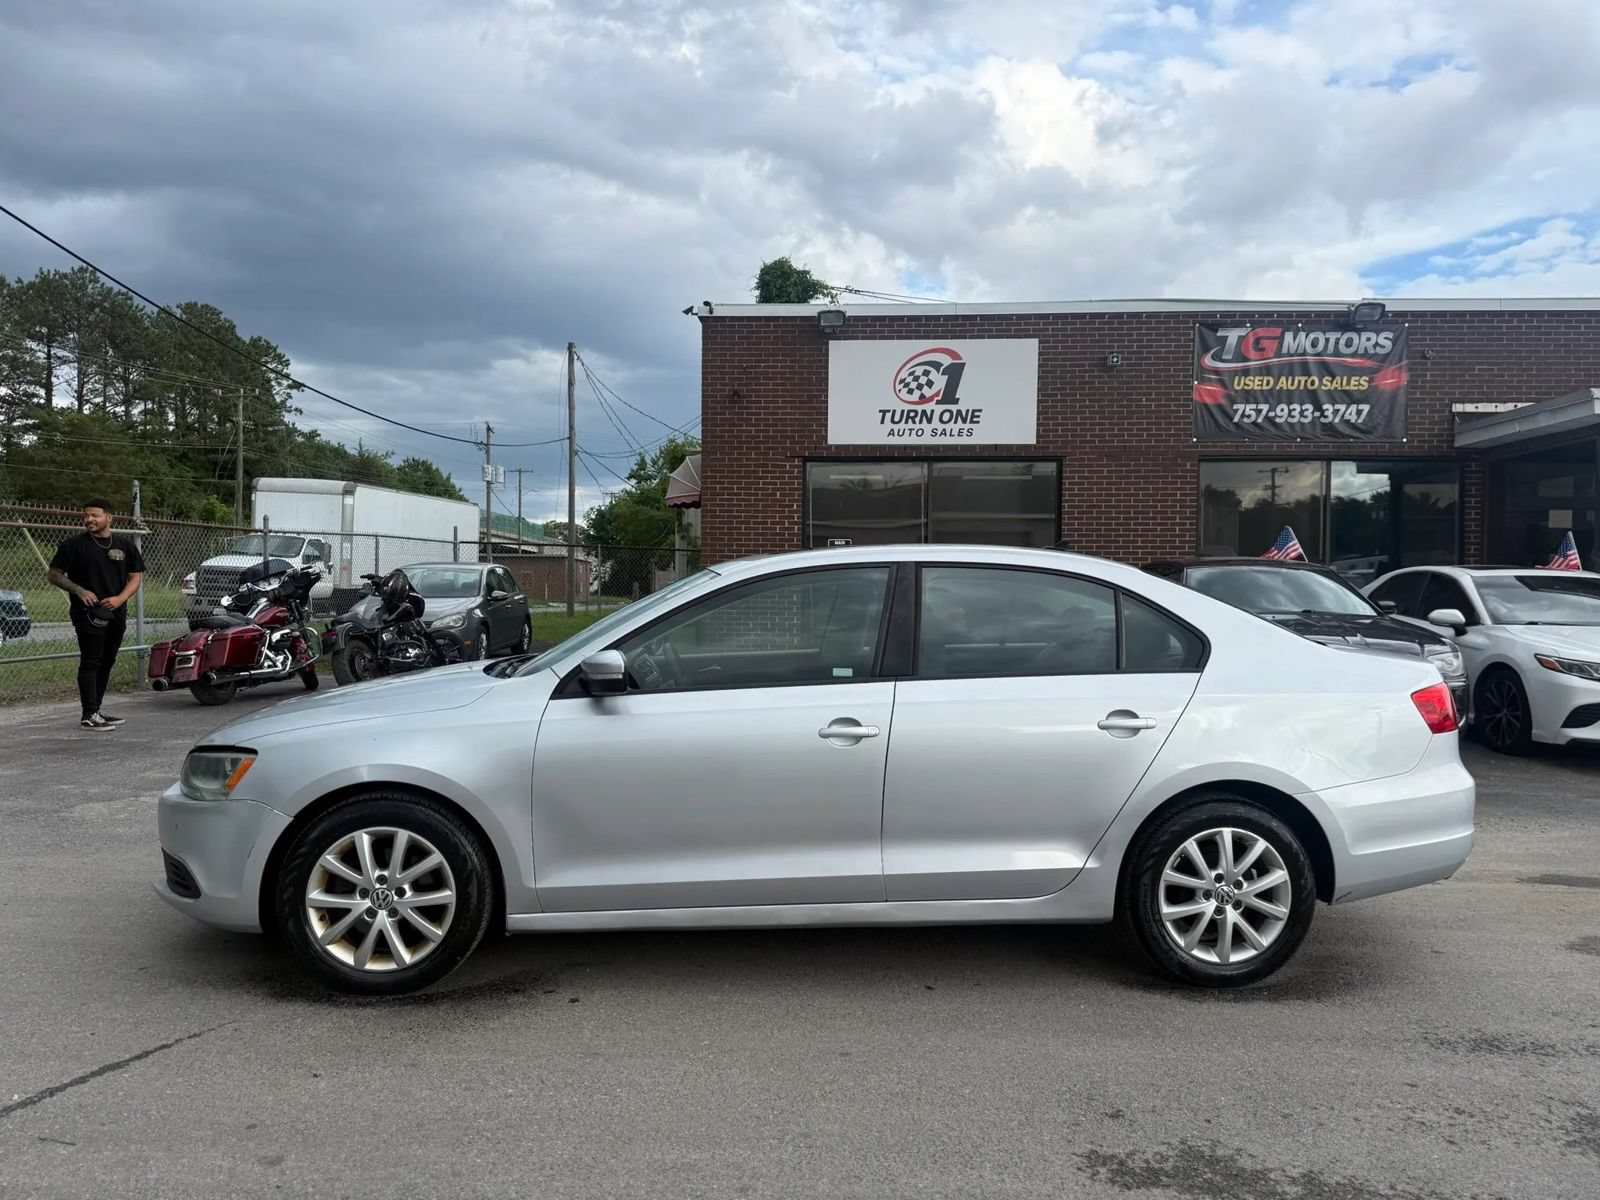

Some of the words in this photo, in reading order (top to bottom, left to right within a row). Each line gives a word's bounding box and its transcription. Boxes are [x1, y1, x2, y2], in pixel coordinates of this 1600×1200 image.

[1216, 327, 1282, 360] TG
[1281, 331, 1394, 354] MOTORS
[935, 362, 966, 405] 1
[1233, 376, 1274, 391] USED
[1276, 376, 1319, 390] AUTO
[1321, 376, 1369, 390] SALES
[879, 409, 935, 424] TURN
[939, 408, 983, 424] ONE
[1232, 403, 1370, 424] 757-933-3747
[887, 428, 925, 437] AUTO
[930, 428, 974, 437] SALES
